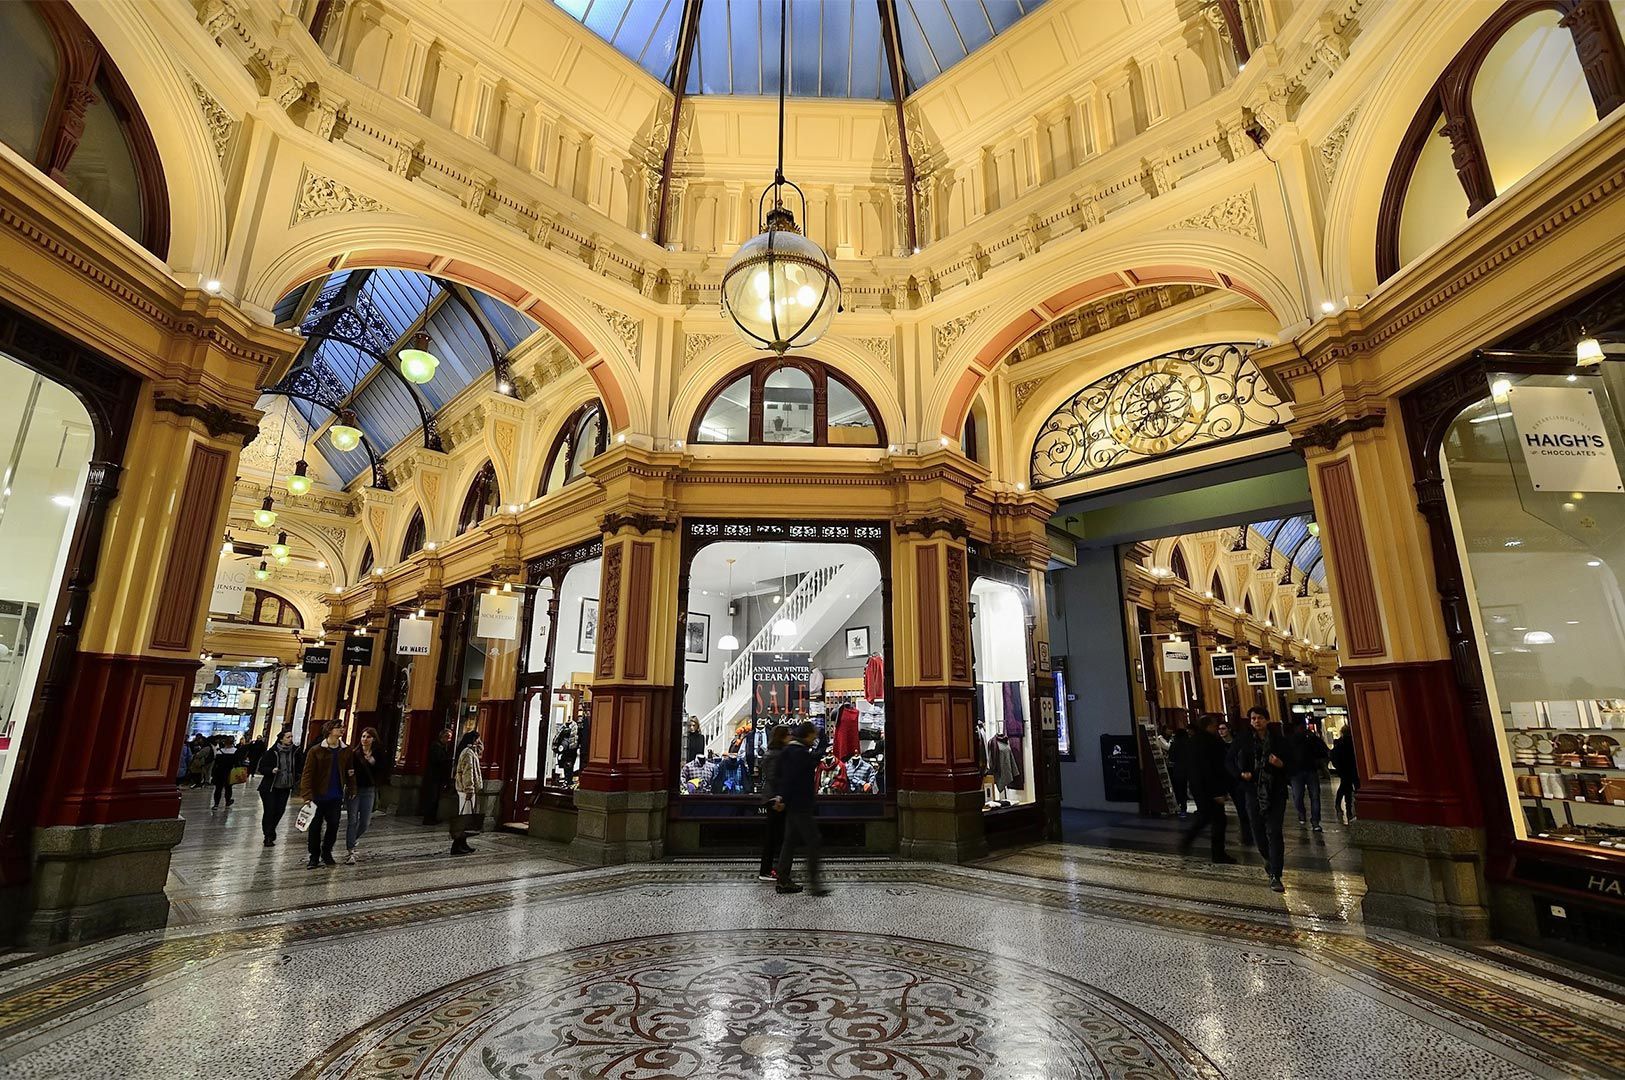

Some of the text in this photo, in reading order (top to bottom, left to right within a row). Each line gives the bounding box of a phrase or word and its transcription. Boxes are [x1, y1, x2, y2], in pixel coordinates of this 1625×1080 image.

[1525, 433, 1605, 448] HAIGH'S
[216, 583, 243, 592] JENSEN
[753, 673, 809, 681] CLEARANCE
[755, 684, 807, 715] SALE
[1588, 875, 1625, 896] HA
